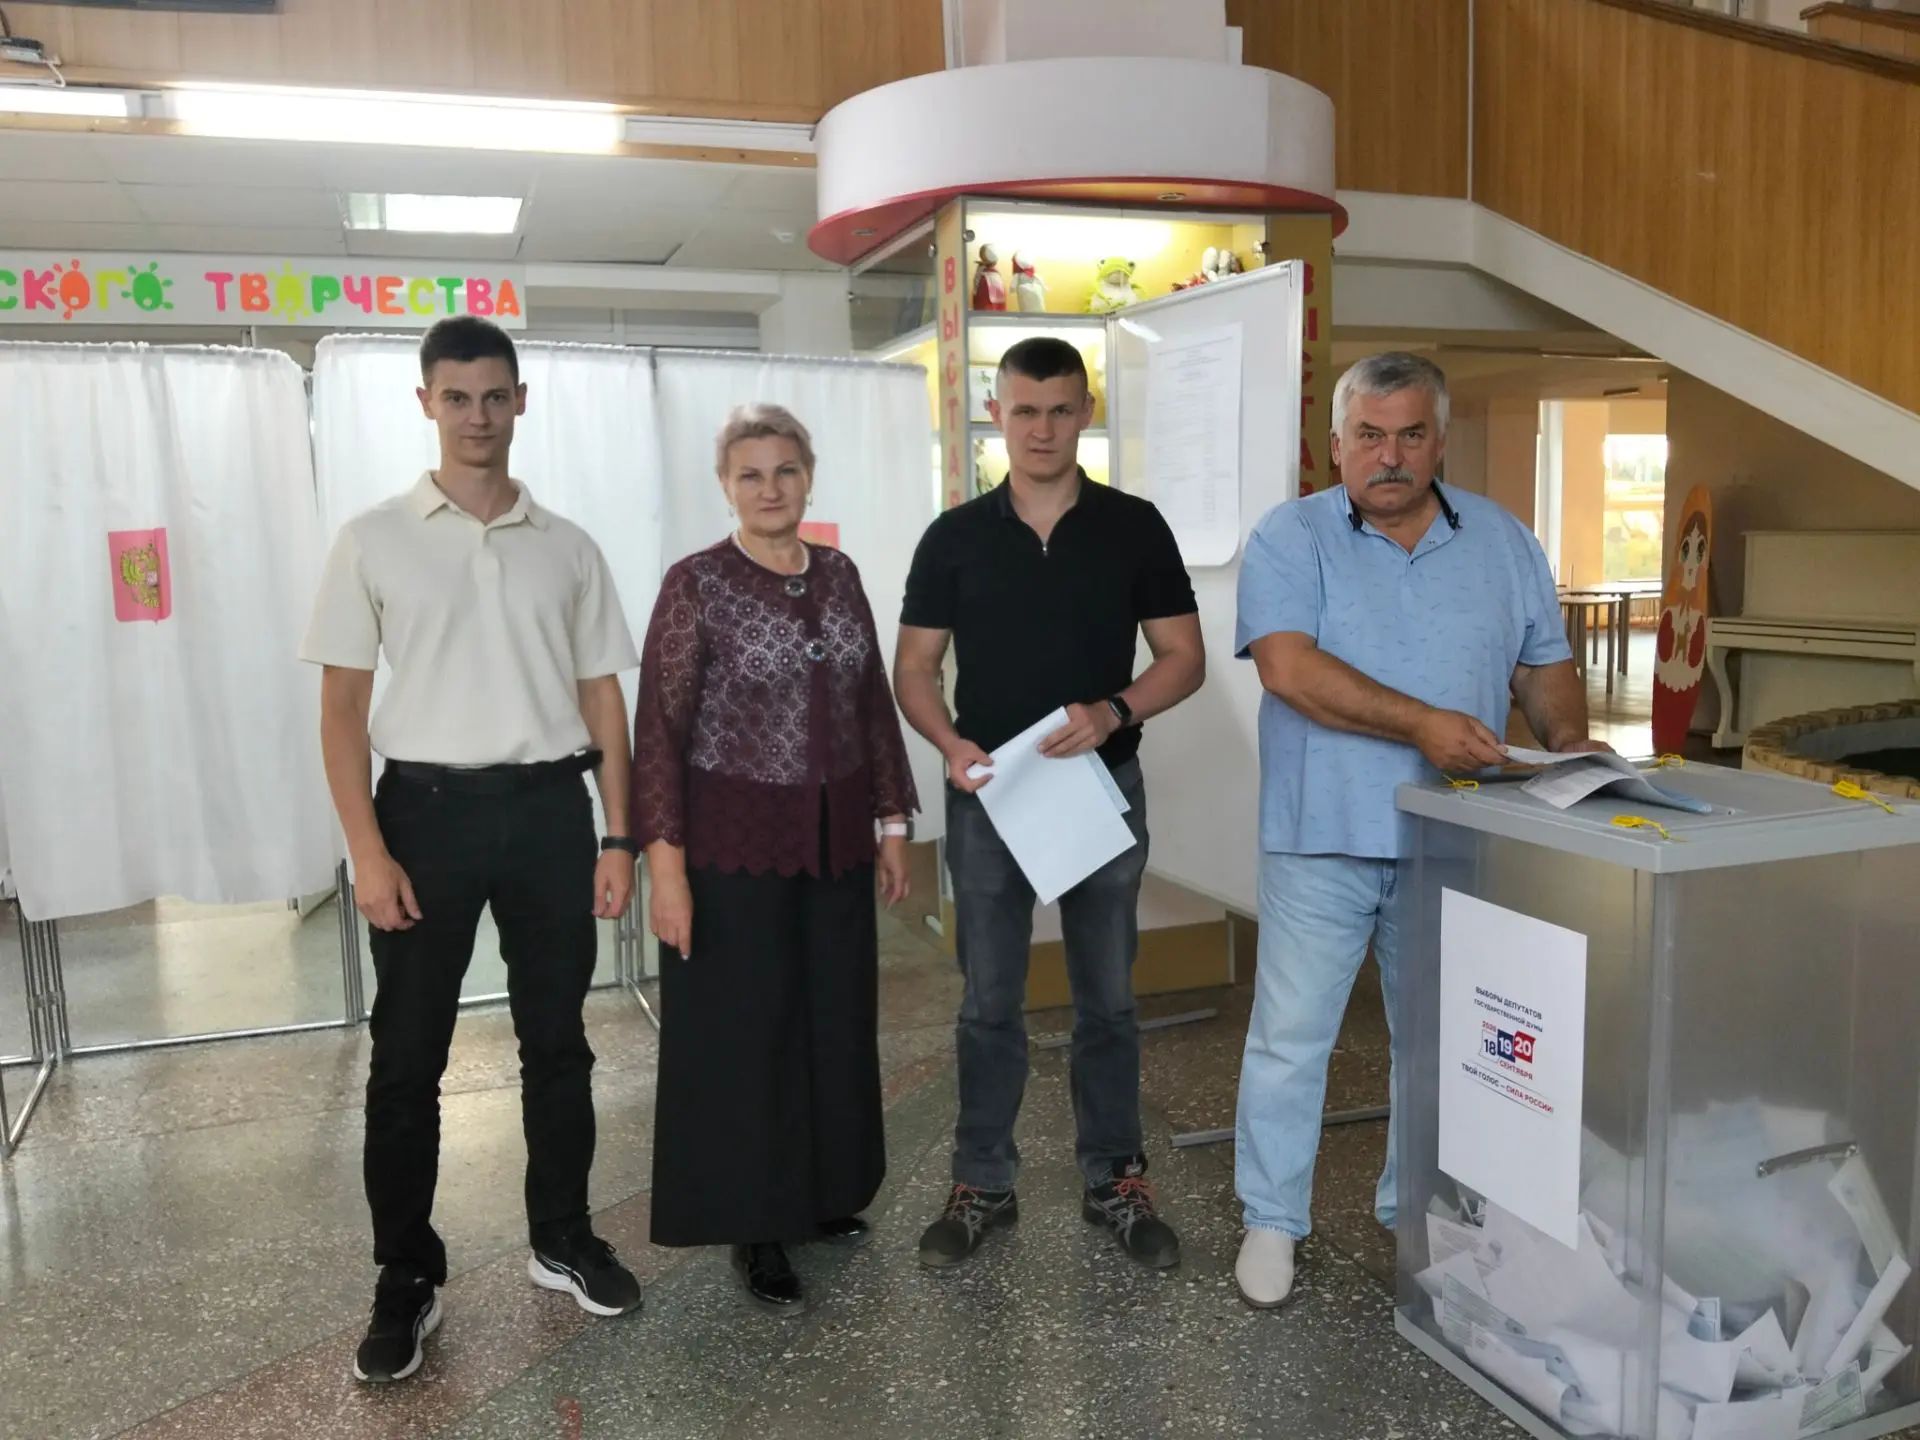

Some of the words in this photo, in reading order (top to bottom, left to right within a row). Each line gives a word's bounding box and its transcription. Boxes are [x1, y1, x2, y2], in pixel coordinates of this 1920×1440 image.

[205, 264, 521, 320] ТВОРЧЕСТВА
[1474, 998, 1526, 1025] ГОСУДАРСТВЕННОЙ
[1525, 1020, 1543, 1033] ДУМЫ
[1475, 986, 1503, 1003] ВЫБОРЫ
[1503, 999, 1542, 1020] ДЕПУТАТОВ
[1484, 1039, 1497, 1056] 18
[1499, 1037, 1512, 1056] 19
[1514, 1036, 1532, 1057] 20
[1461, 1062, 1478, 1076] ТВОЙ
[1479, 1071, 1499, 1087] ГОЛОС
[1506, 1085, 1523, 1099] СИЛА
[1500, 1060, 1533, 1080] СЕНТЯБРЯ
